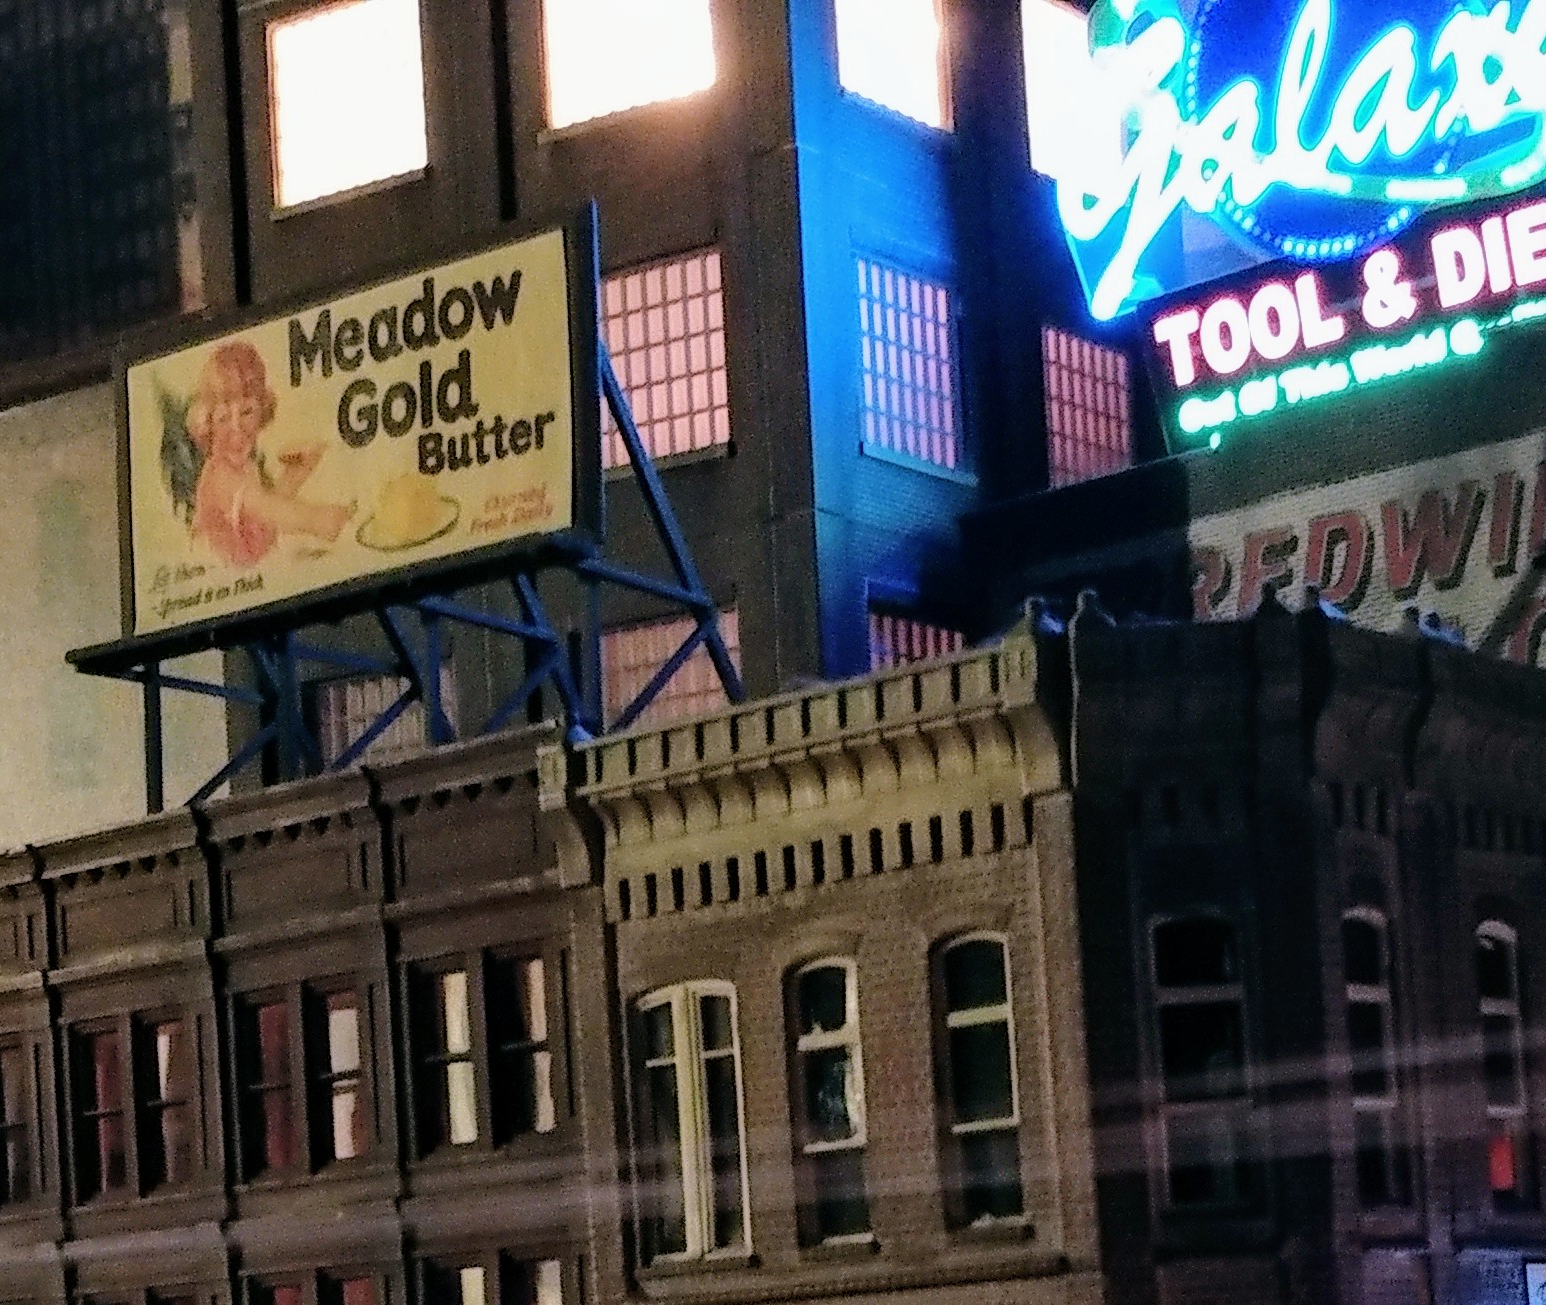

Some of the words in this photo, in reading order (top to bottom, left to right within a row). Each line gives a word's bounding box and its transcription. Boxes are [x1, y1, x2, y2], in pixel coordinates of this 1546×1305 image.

[287, 269, 522, 388] Meadow
[1153, 271, 1345, 388] TOOL
[1359, 250, 1418, 333] &
[336, 348, 479, 449] Gold
[417, 408, 556, 477] Butter
